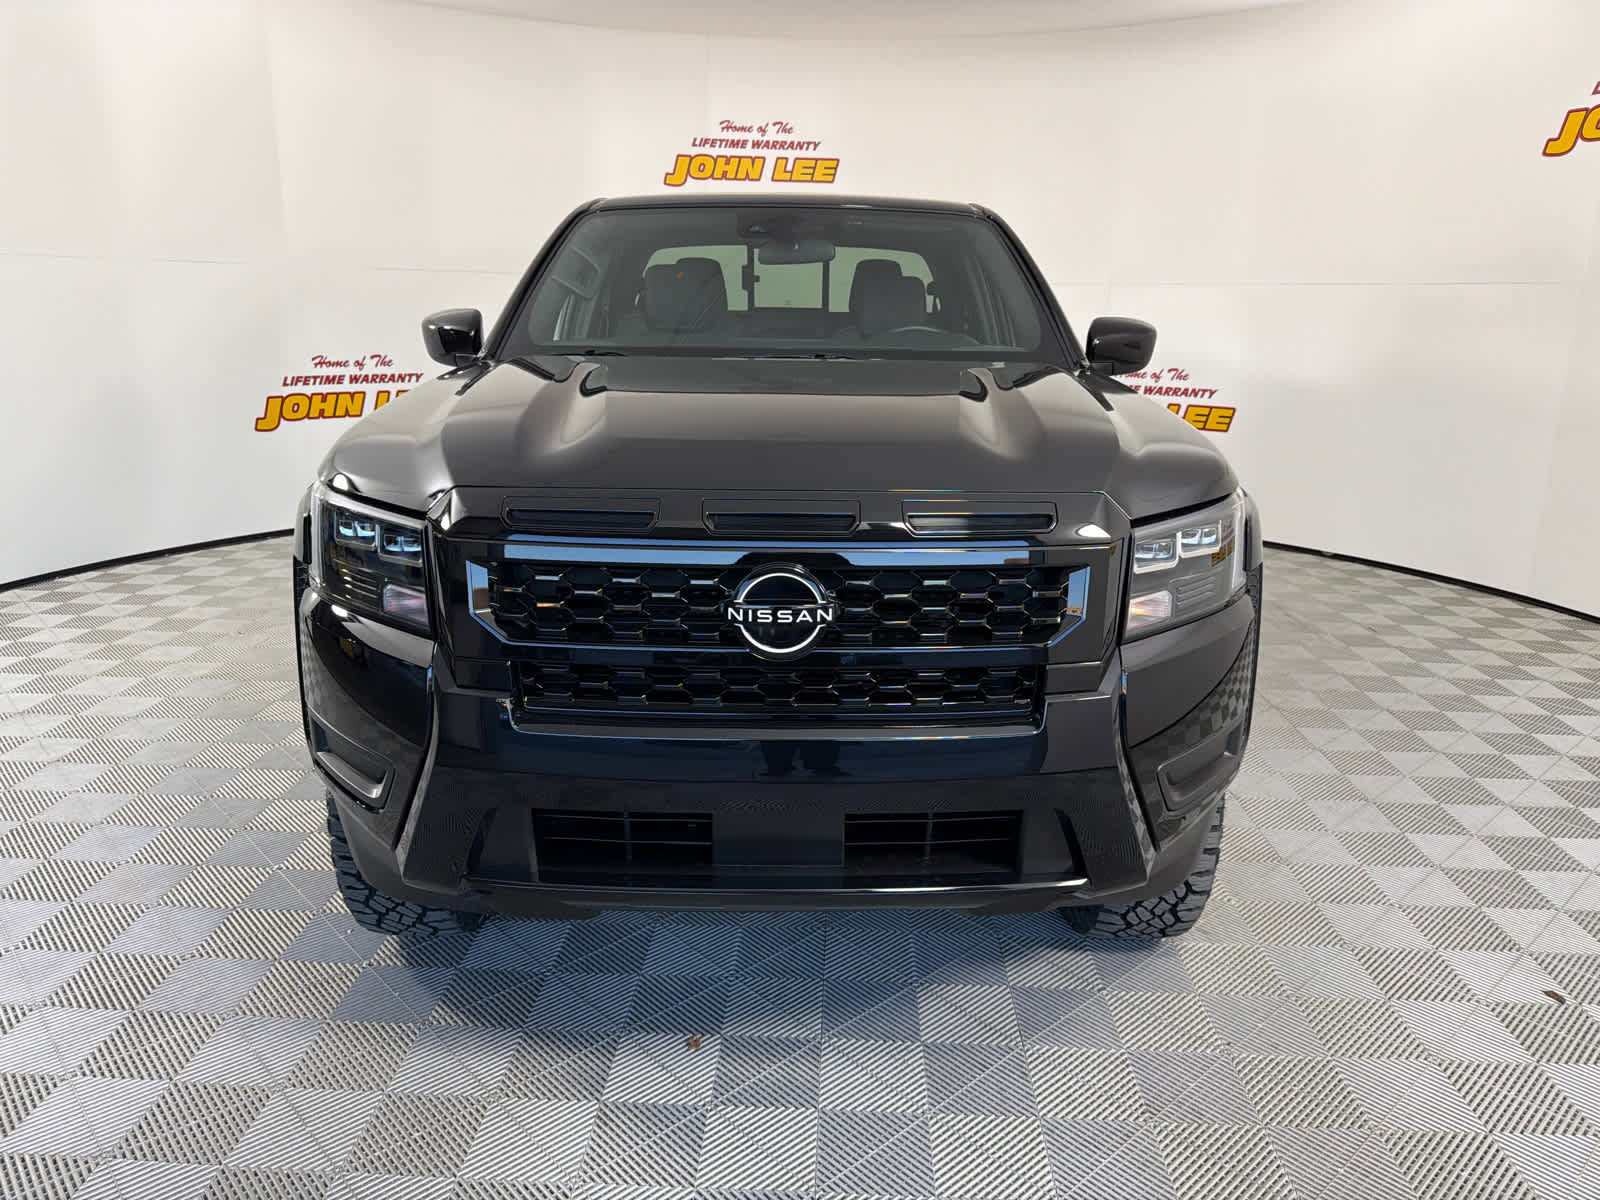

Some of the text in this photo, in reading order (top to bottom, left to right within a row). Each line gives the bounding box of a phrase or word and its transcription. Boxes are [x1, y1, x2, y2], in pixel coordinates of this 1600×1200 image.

[719, 119, 793, 137] Home of The
[691, 137, 821, 151] LIFETIME WARRANTY
[664, 154, 840, 187] JOHN LEE
[311, 354, 393, 371] Home of The
[282, 373, 424, 387] LIFETIME WARRANTY
[1150, 368, 1164, 383] of
[1167, 368, 1190, 381] The
[1143, 385, 1218, 399] WARRANTY
[255, 391, 366, 432] JOHN
[727, 607, 833, 623] NISSAN
